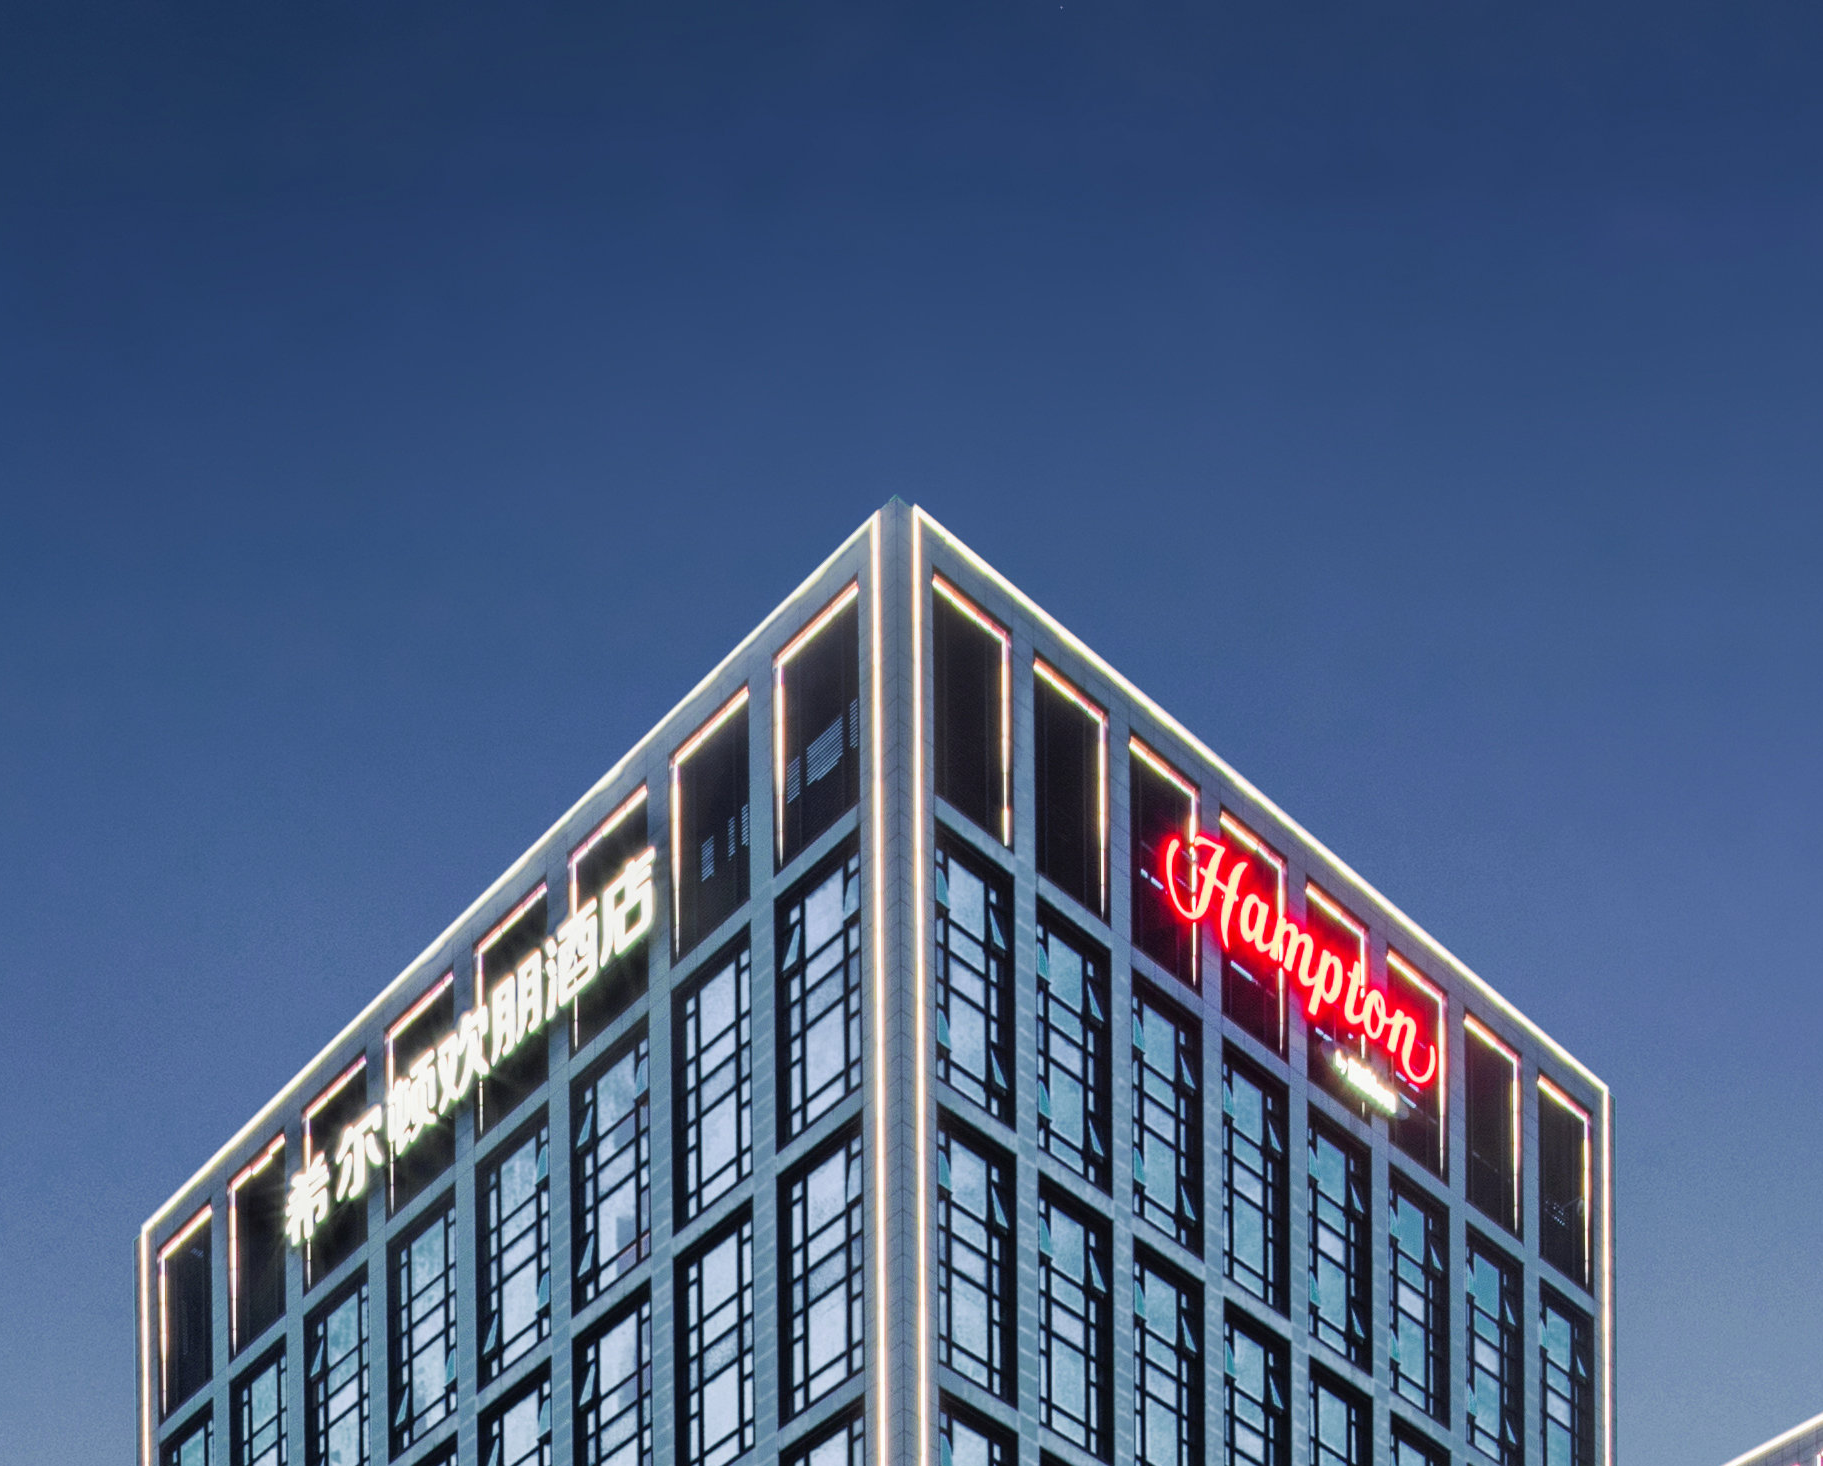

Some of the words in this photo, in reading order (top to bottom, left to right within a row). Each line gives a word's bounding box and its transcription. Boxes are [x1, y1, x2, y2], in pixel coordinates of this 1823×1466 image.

[285, 845, 657, 1247] 希尔顿欢朋酒店
[1165, 836, 1436, 1084] Hampton
